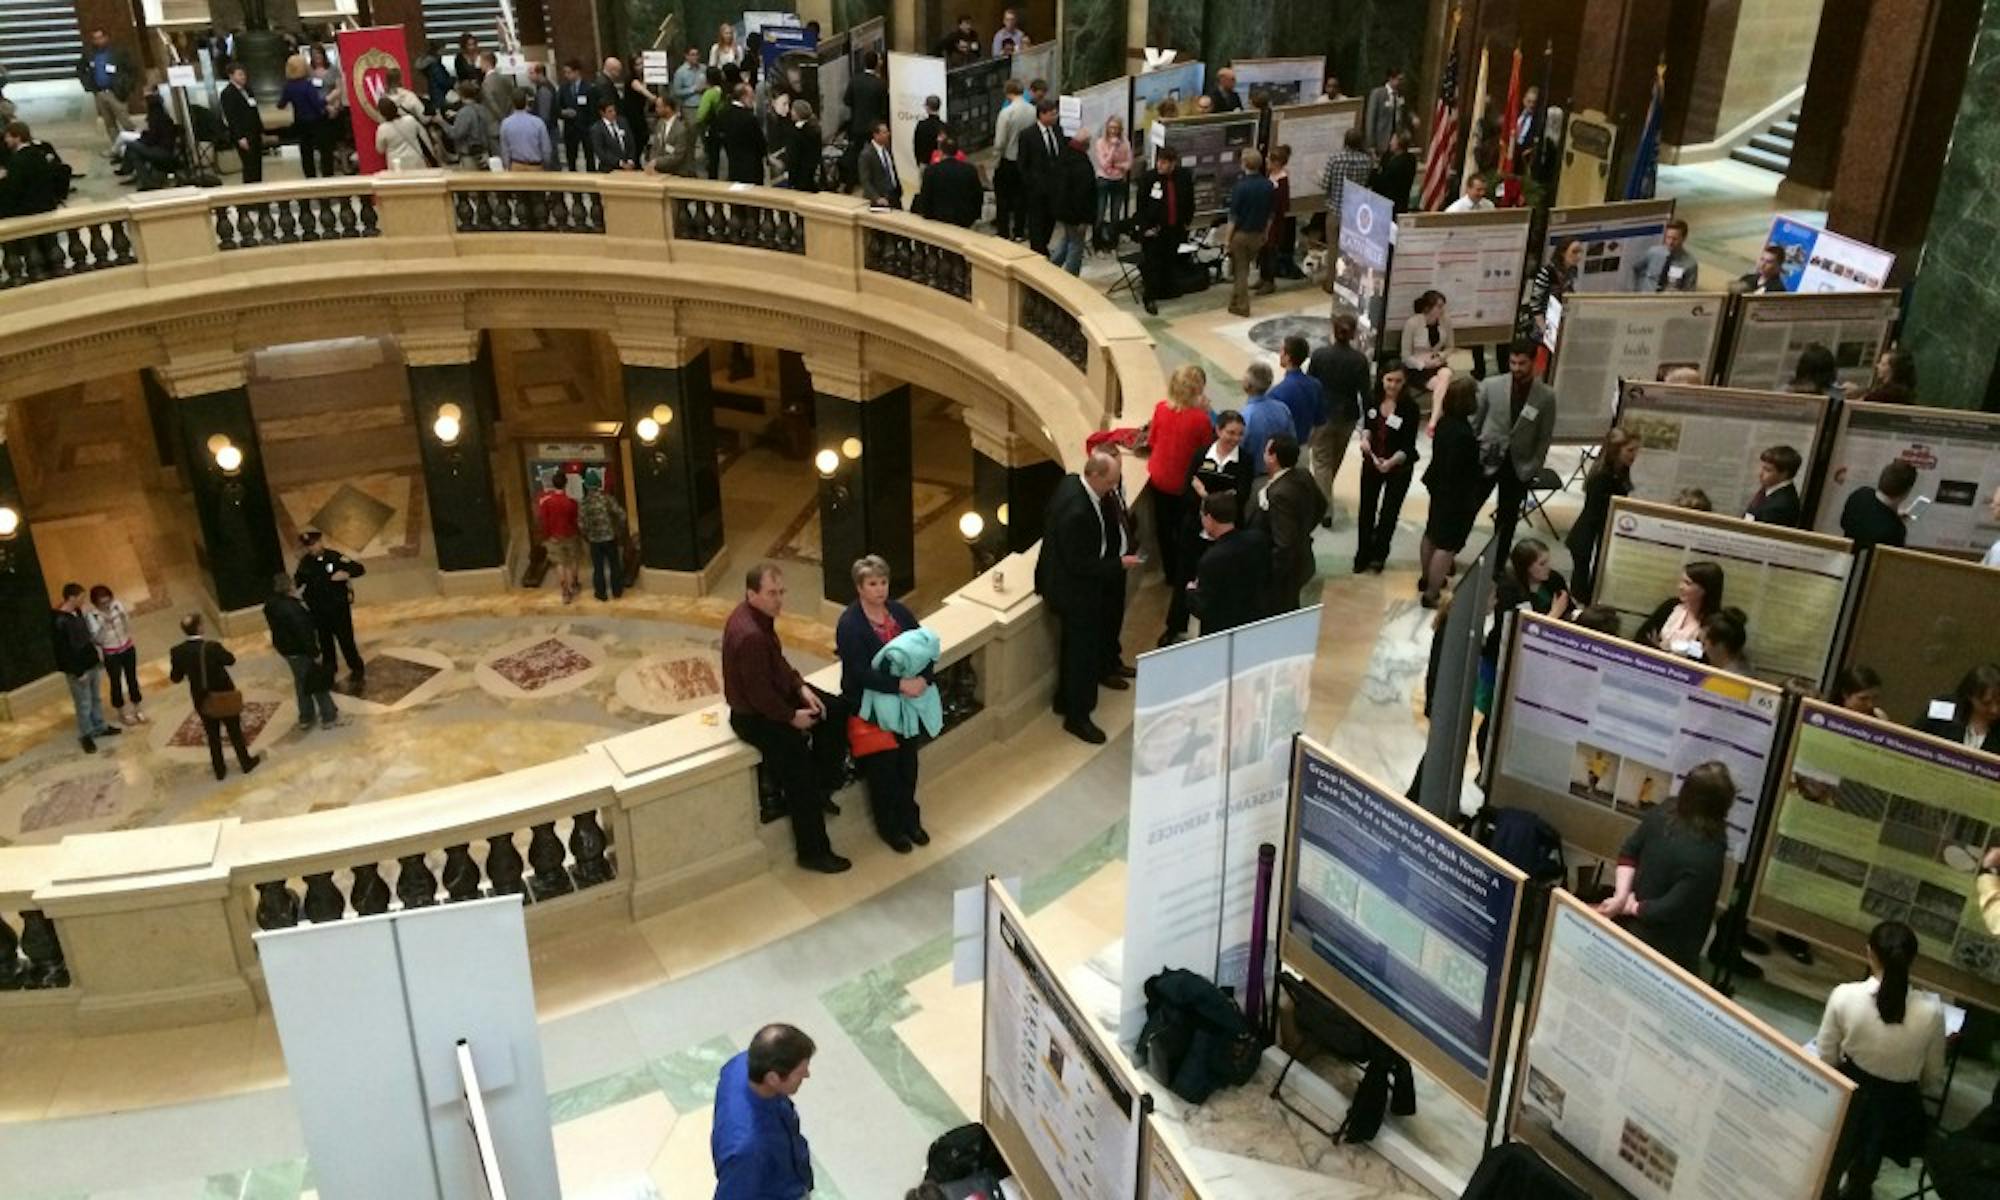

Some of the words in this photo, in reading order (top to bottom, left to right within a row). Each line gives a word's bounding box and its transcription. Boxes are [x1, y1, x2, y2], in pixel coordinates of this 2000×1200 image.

[1541, 629, 1580, 650] University
[1581, 642, 1592, 652] of
[1826, 718, 1872, 742] University
[1308, 762, 1339, 784] Group
[1338, 775, 1364, 801] Home
[1364, 794, 1410, 831] Evaluation
[1409, 822, 1424, 839] for
[1422, 833, 1458, 863] At-Risk
[1490, 877, 1501, 891] A
[1316, 780, 1339, 798] Case
[1340, 791, 1363, 816] Study
[1380, 818, 1428, 858] Non-Profit
[1426, 850, 1488, 898] Organization
